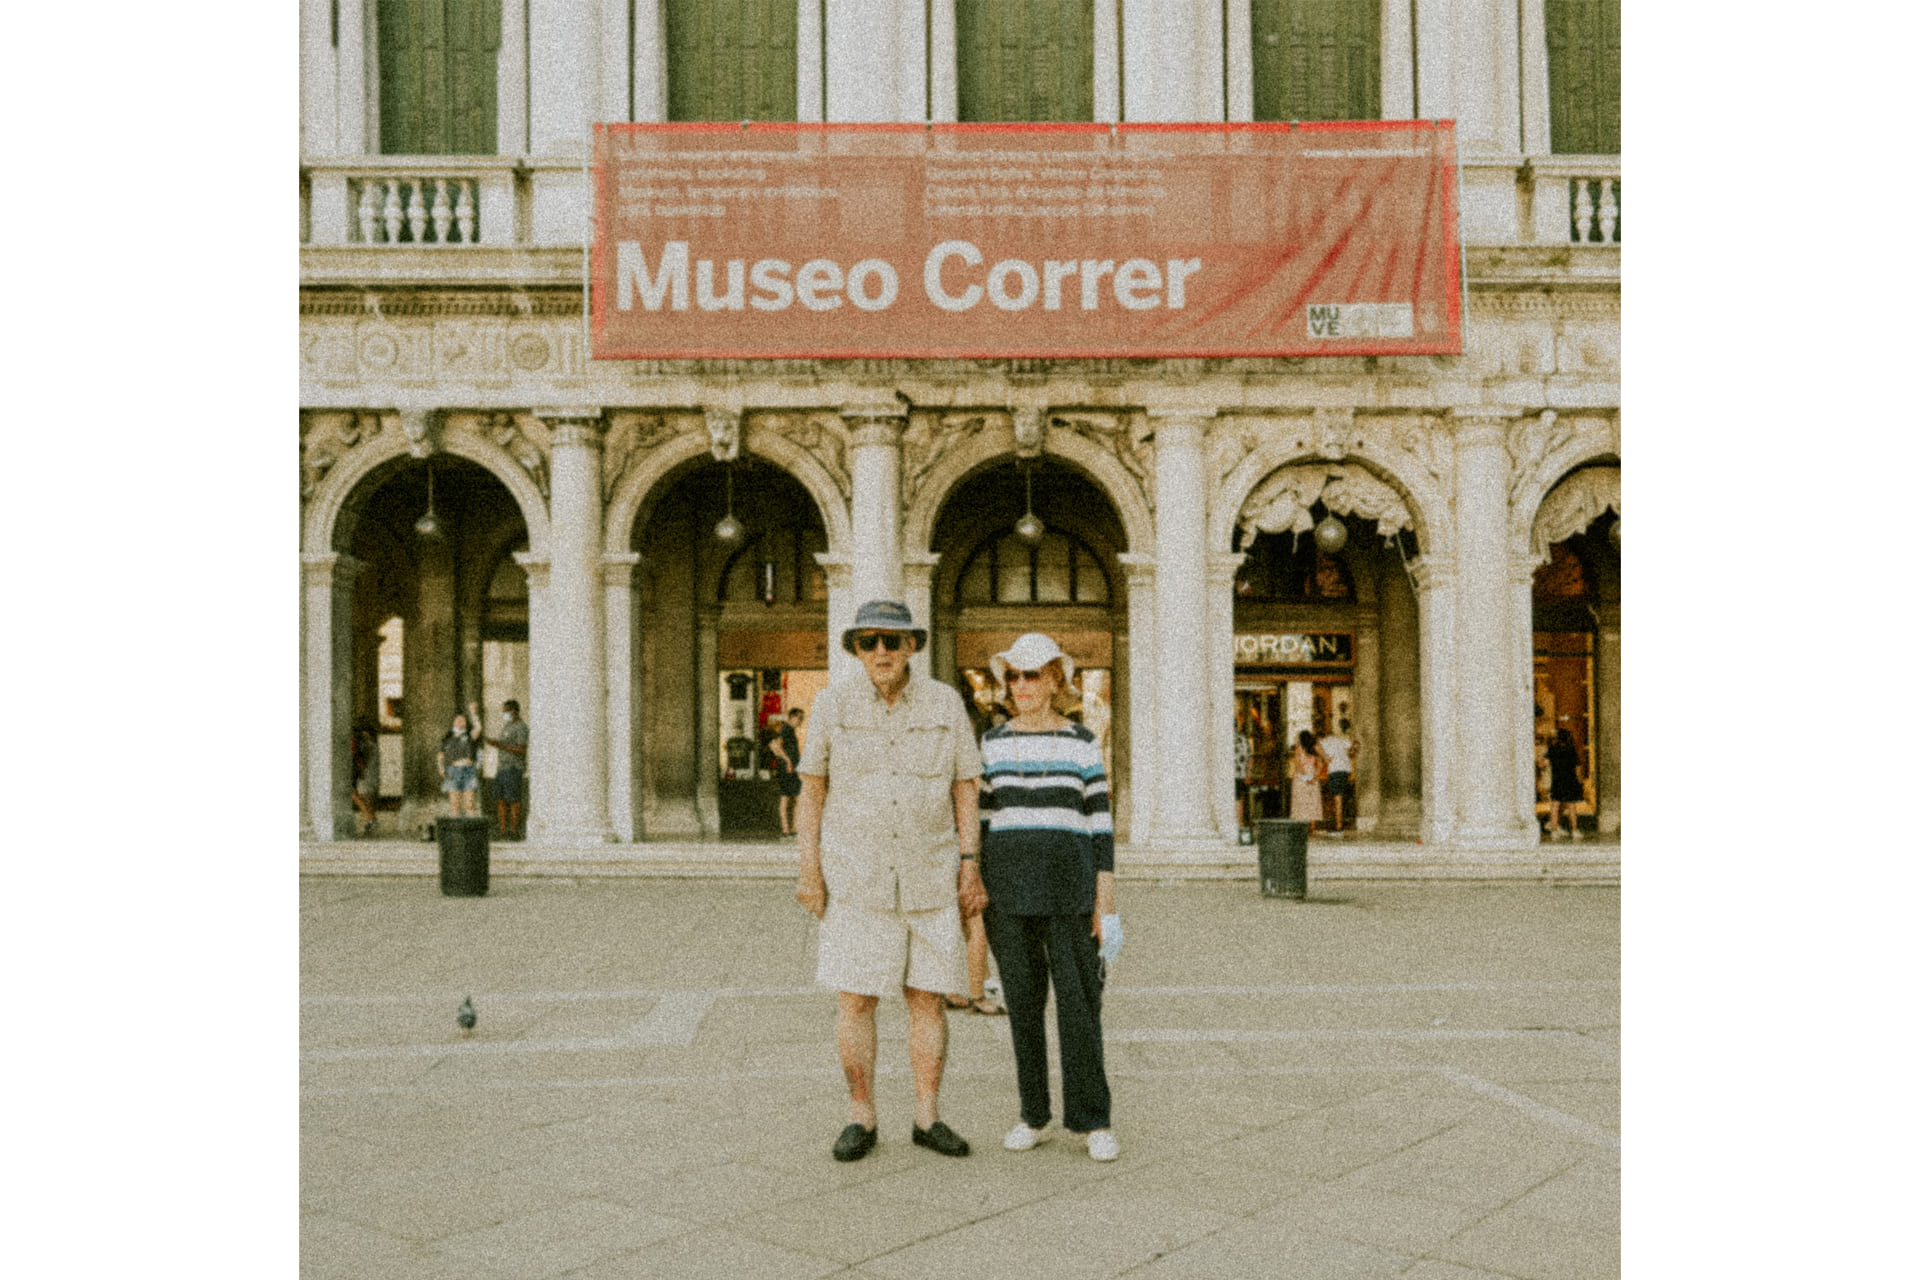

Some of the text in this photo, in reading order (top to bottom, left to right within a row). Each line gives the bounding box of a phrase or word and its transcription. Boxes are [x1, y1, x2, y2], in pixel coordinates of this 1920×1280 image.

[617, 239, 1202, 312] Museo Correr
[1309, 306, 1340, 321] MU
[1311, 321, 1340, 335] VE
